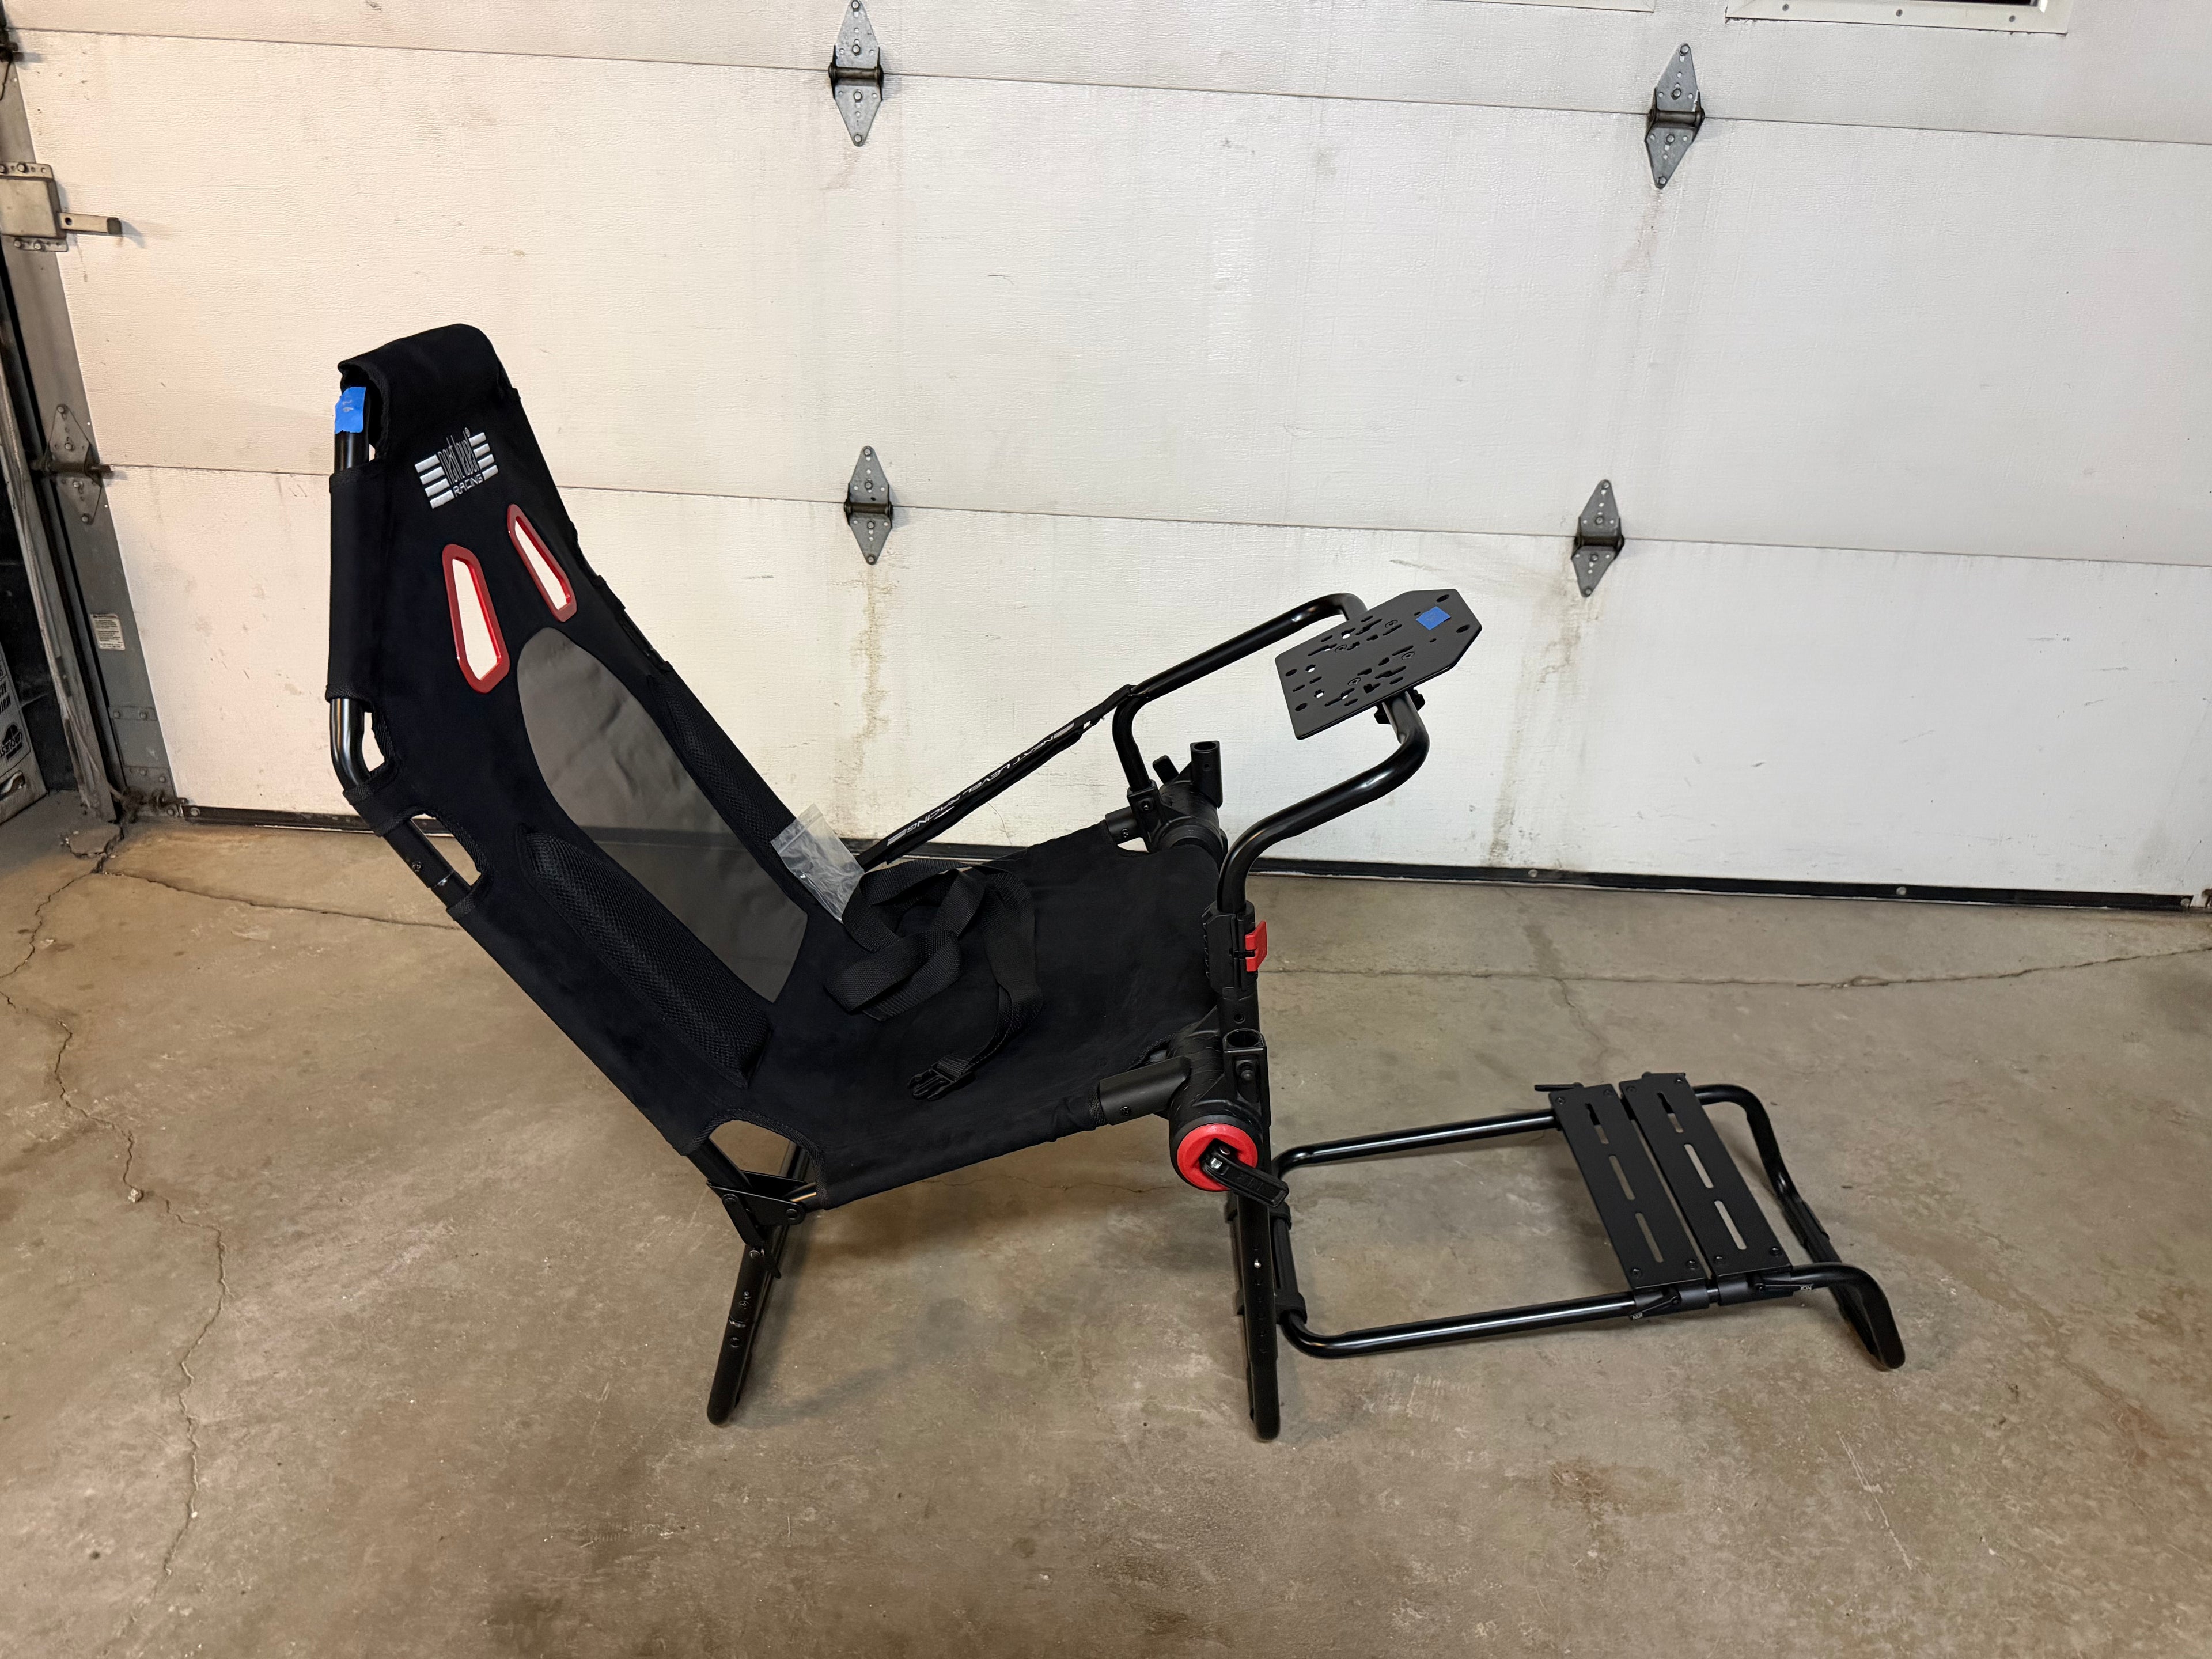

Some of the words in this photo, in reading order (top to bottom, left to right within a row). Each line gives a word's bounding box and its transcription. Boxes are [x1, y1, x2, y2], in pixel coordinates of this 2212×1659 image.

[1013, 736, 1055, 766] NEXT
[963, 763, 1011, 795] LEVEL
[907, 795, 961, 831] RACING
